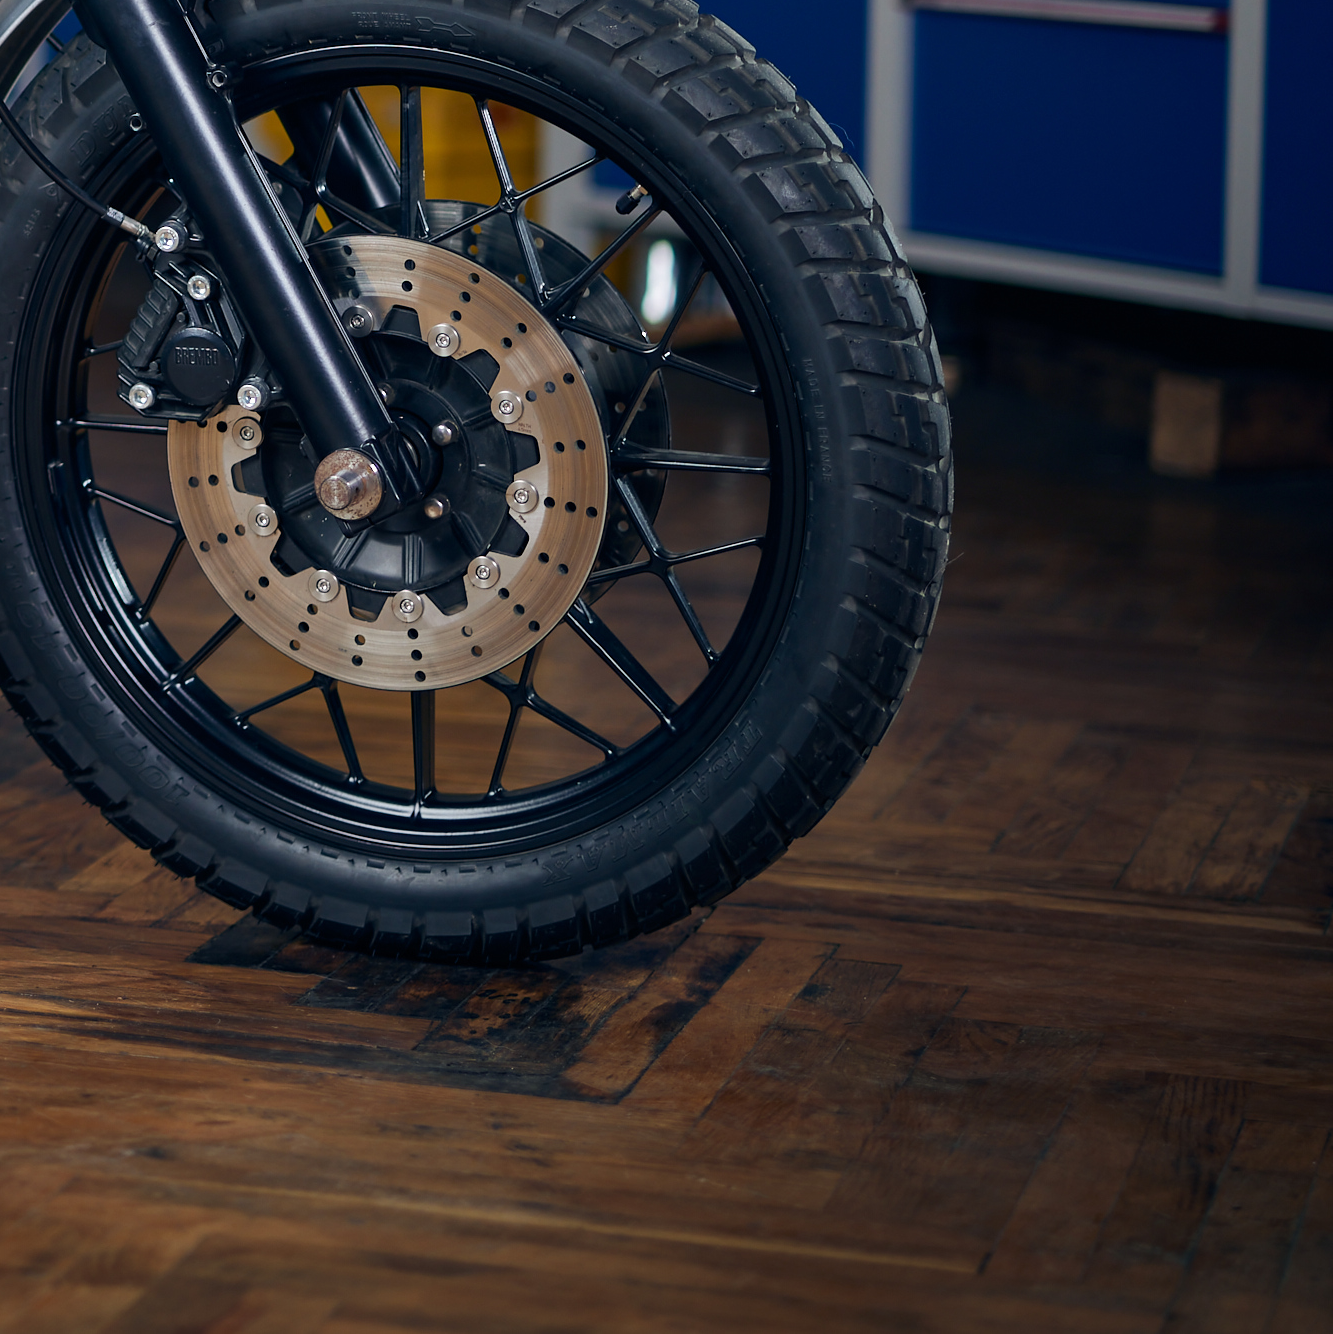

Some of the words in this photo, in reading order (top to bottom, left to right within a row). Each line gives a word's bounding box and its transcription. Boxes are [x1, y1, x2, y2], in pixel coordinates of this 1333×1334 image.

[174, 346, 219, 366] BREMBO
[802, 358, 821, 397] MADE
[813, 404, 826, 419] IN
[817, 426, 833, 484] FRANCE
[542, 720, 763, 887] TRAILMAX
